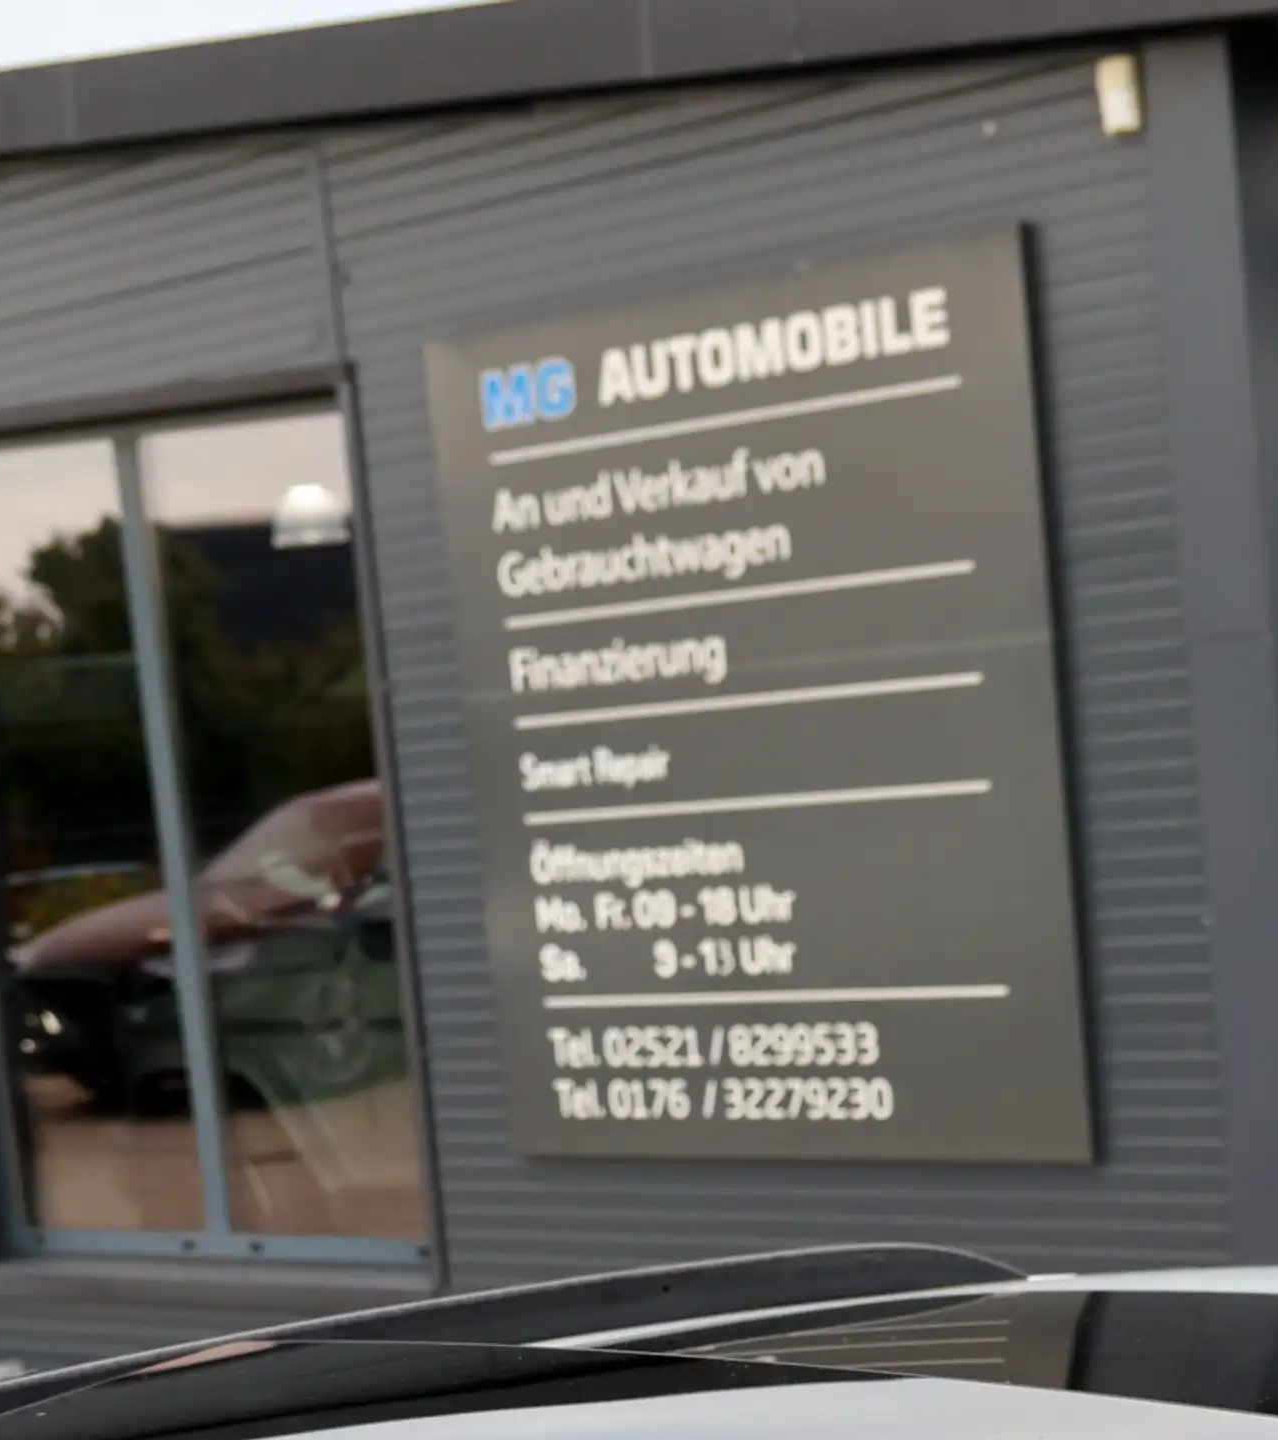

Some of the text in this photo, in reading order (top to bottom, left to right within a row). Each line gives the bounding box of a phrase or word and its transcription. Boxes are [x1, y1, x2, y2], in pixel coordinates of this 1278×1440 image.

[479, 286, 951, 431] MG AUTOMOBILE
[492, 446, 827, 534] An und Verkauf von
[497, 523, 793, 598] Gebrauchtwagen
[508, 635, 727, 693] Finanzierung
[519, 744, 671, 792] Smart Repair
[529, 837, 746, 889] Öffnungszeiten
[736, 880, 797, 925] Uhr
[538, 942, 587, 984] Sa.
[652, 936, 678, 979] 9
[696, 936, 737, 977] 13
[736, 933, 798, 976] Uhr
[545, 1026, 601, 1069] Tel.
[601, 1025, 705, 1068] 02521
[726, 1021, 881, 1067] 8299533
[551, 1077, 607, 1120] Tel.
[606, 1077, 692, 1120] 0176
[721, 1076, 895, 1121] 32279230
